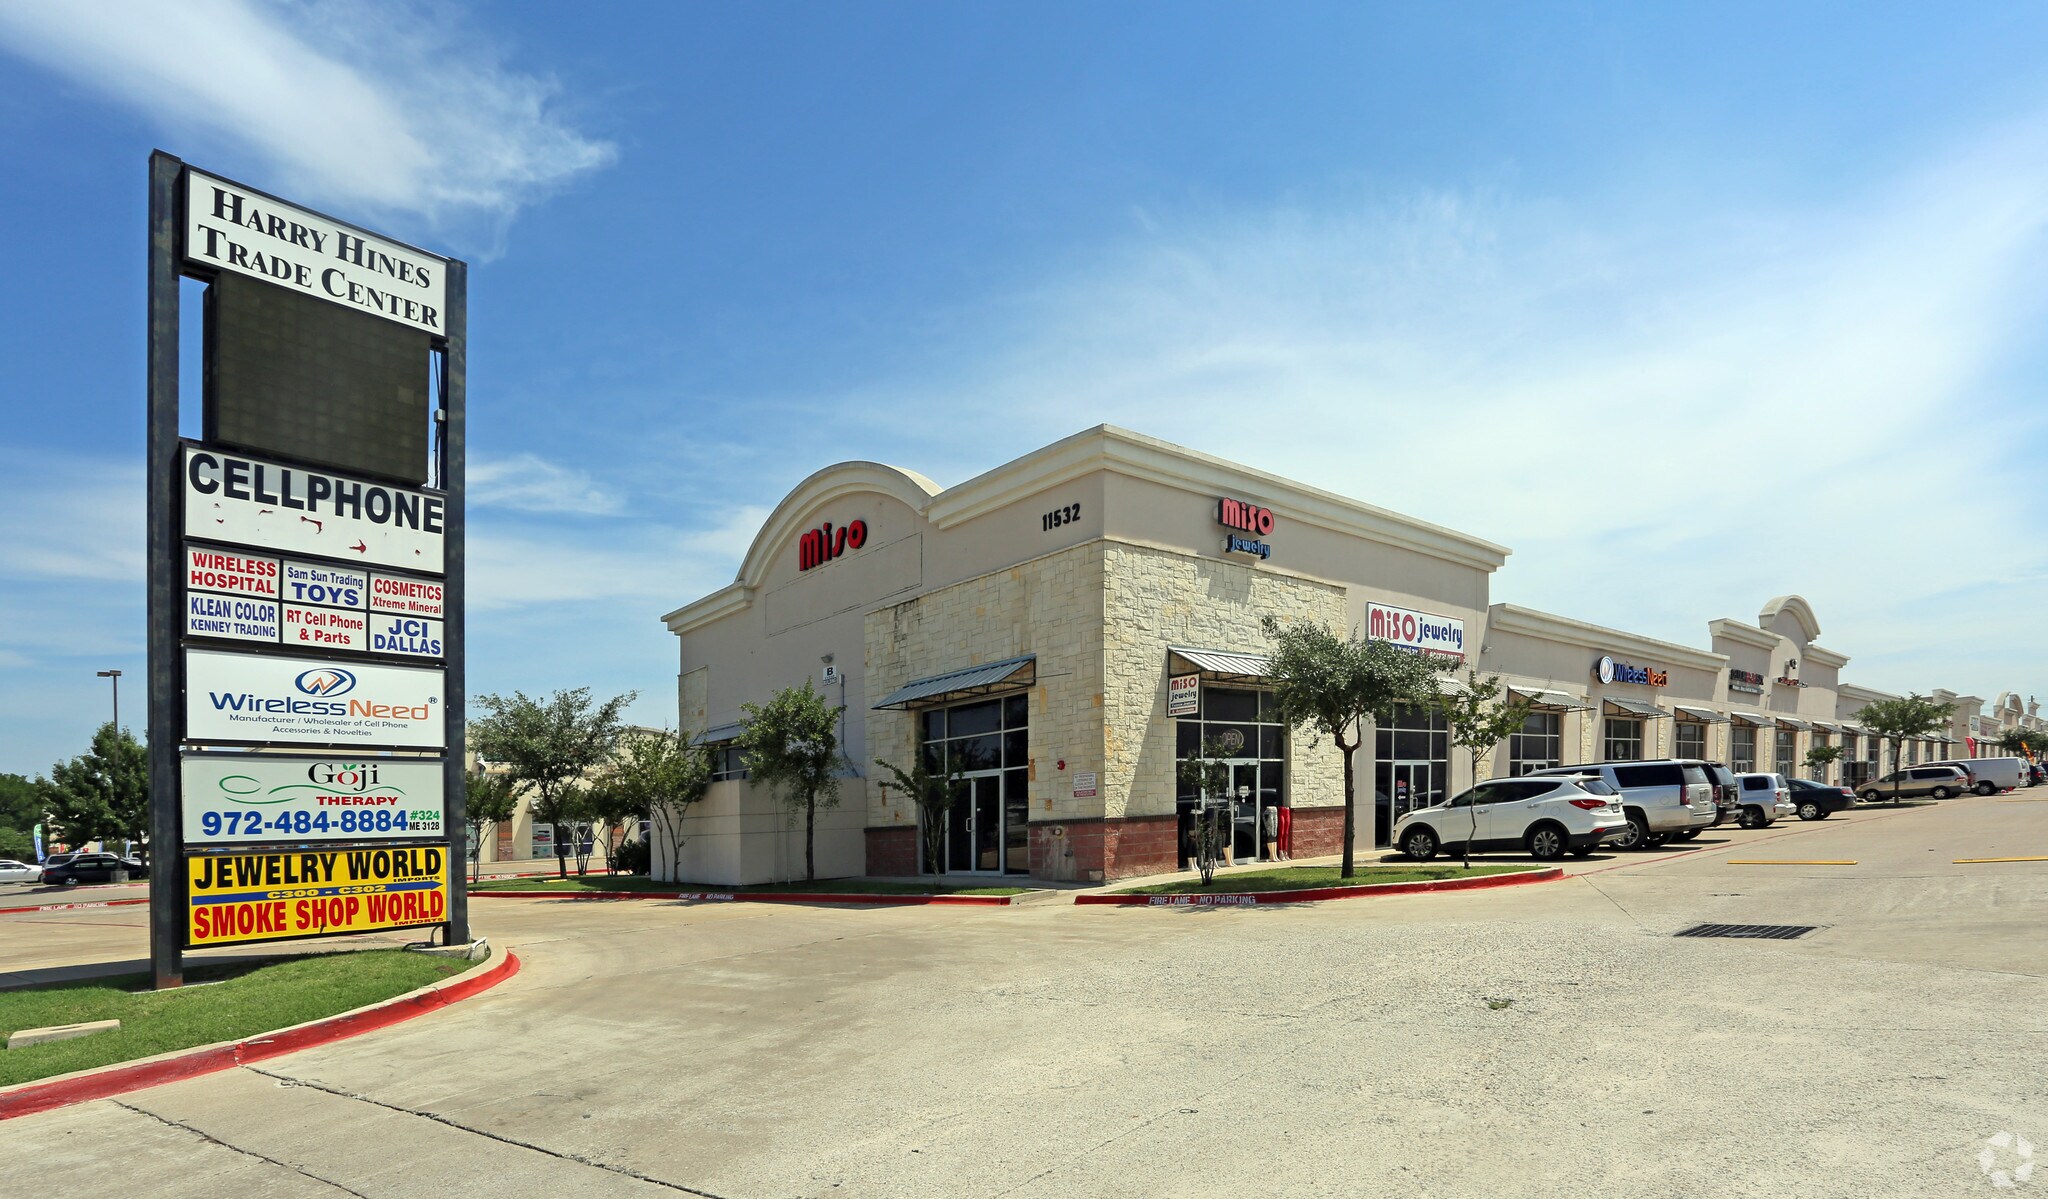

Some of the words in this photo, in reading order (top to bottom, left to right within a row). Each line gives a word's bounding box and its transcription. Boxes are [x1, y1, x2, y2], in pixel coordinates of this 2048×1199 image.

[210, 186, 328, 254] HARRY
[335, 230, 431, 289] HINES
[197, 223, 313, 289] TRADE
[321, 268, 439, 329] CENTER
[188, 453, 443, 535] CELLPHONE
[1042, 503, 1081, 532] 11532
[1229, 534, 1271, 560] jewelry
[192, 552, 277, 577] WIRELESS
[191, 571, 275, 594] HOSPITAL
[287, 566, 308, 580] Sam
[311, 569, 328, 582] Sun
[330, 572, 363, 590] Trading
[291, 582, 359, 606] TOYS
[374, 578, 442, 601] COSMETICS
[191, 597, 231, 618] KLEAN
[235, 602, 275, 623] COLOR
[372, 596, 406, 610] Xtreme
[408, 600, 442, 614] Mineral
[191, 618, 231, 633] KENNEY
[234, 622, 276, 638] TRADING
[286, 609, 302, 623] RT
[305, 611, 328, 627] Cell
[330, 614, 363, 631] Phone
[388, 619, 428, 638] JCI
[299, 628, 310, 641] &
[314, 630, 351, 645] Parts
[1417, 616, 1463, 650] jewelry
[374, 634, 441, 655] DALLAS
[826, 667, 834, 676] B
[1171, 690, 1197, 702] jewelry
[229, 714, 295, 724] Manufacturer
[303, 717, 352, 727] Wholesaler
[354, 719, 363, 727] of
[364, 720, 380, 728] Cell
[382, 721, 409, 729] Phone
[272, 726, 321, 735] Accessories
[333, 728, 373, 737] Novelties
[308, 762, 380, 792] Goji
[316, 796, 399, 806] THERAPY
[201, 810, 408, 836] 972-484-8884
[409, 821, 421, 831] ME
[422, 821, 440, 831] 3128
[410, 810, 440, 821] #324
[194, 852, 339, 889] JEWELRY
[346, 848, 442, 881] WORLD
[267, 888, 319, 900] C300
[338, 885, 387, 895] C302
[1149, 896, 1168, 905] FIRE
[1199, 896, 1212, 905] NO
[1214, 895, 1256, 904] PARKING
[194, 901, 287, 939] SMOKE
[296, 897, 360, 930] SHOP
[367, 890, 444, 924] WORLD
[394, 917, 444, 926] IMPORTS
